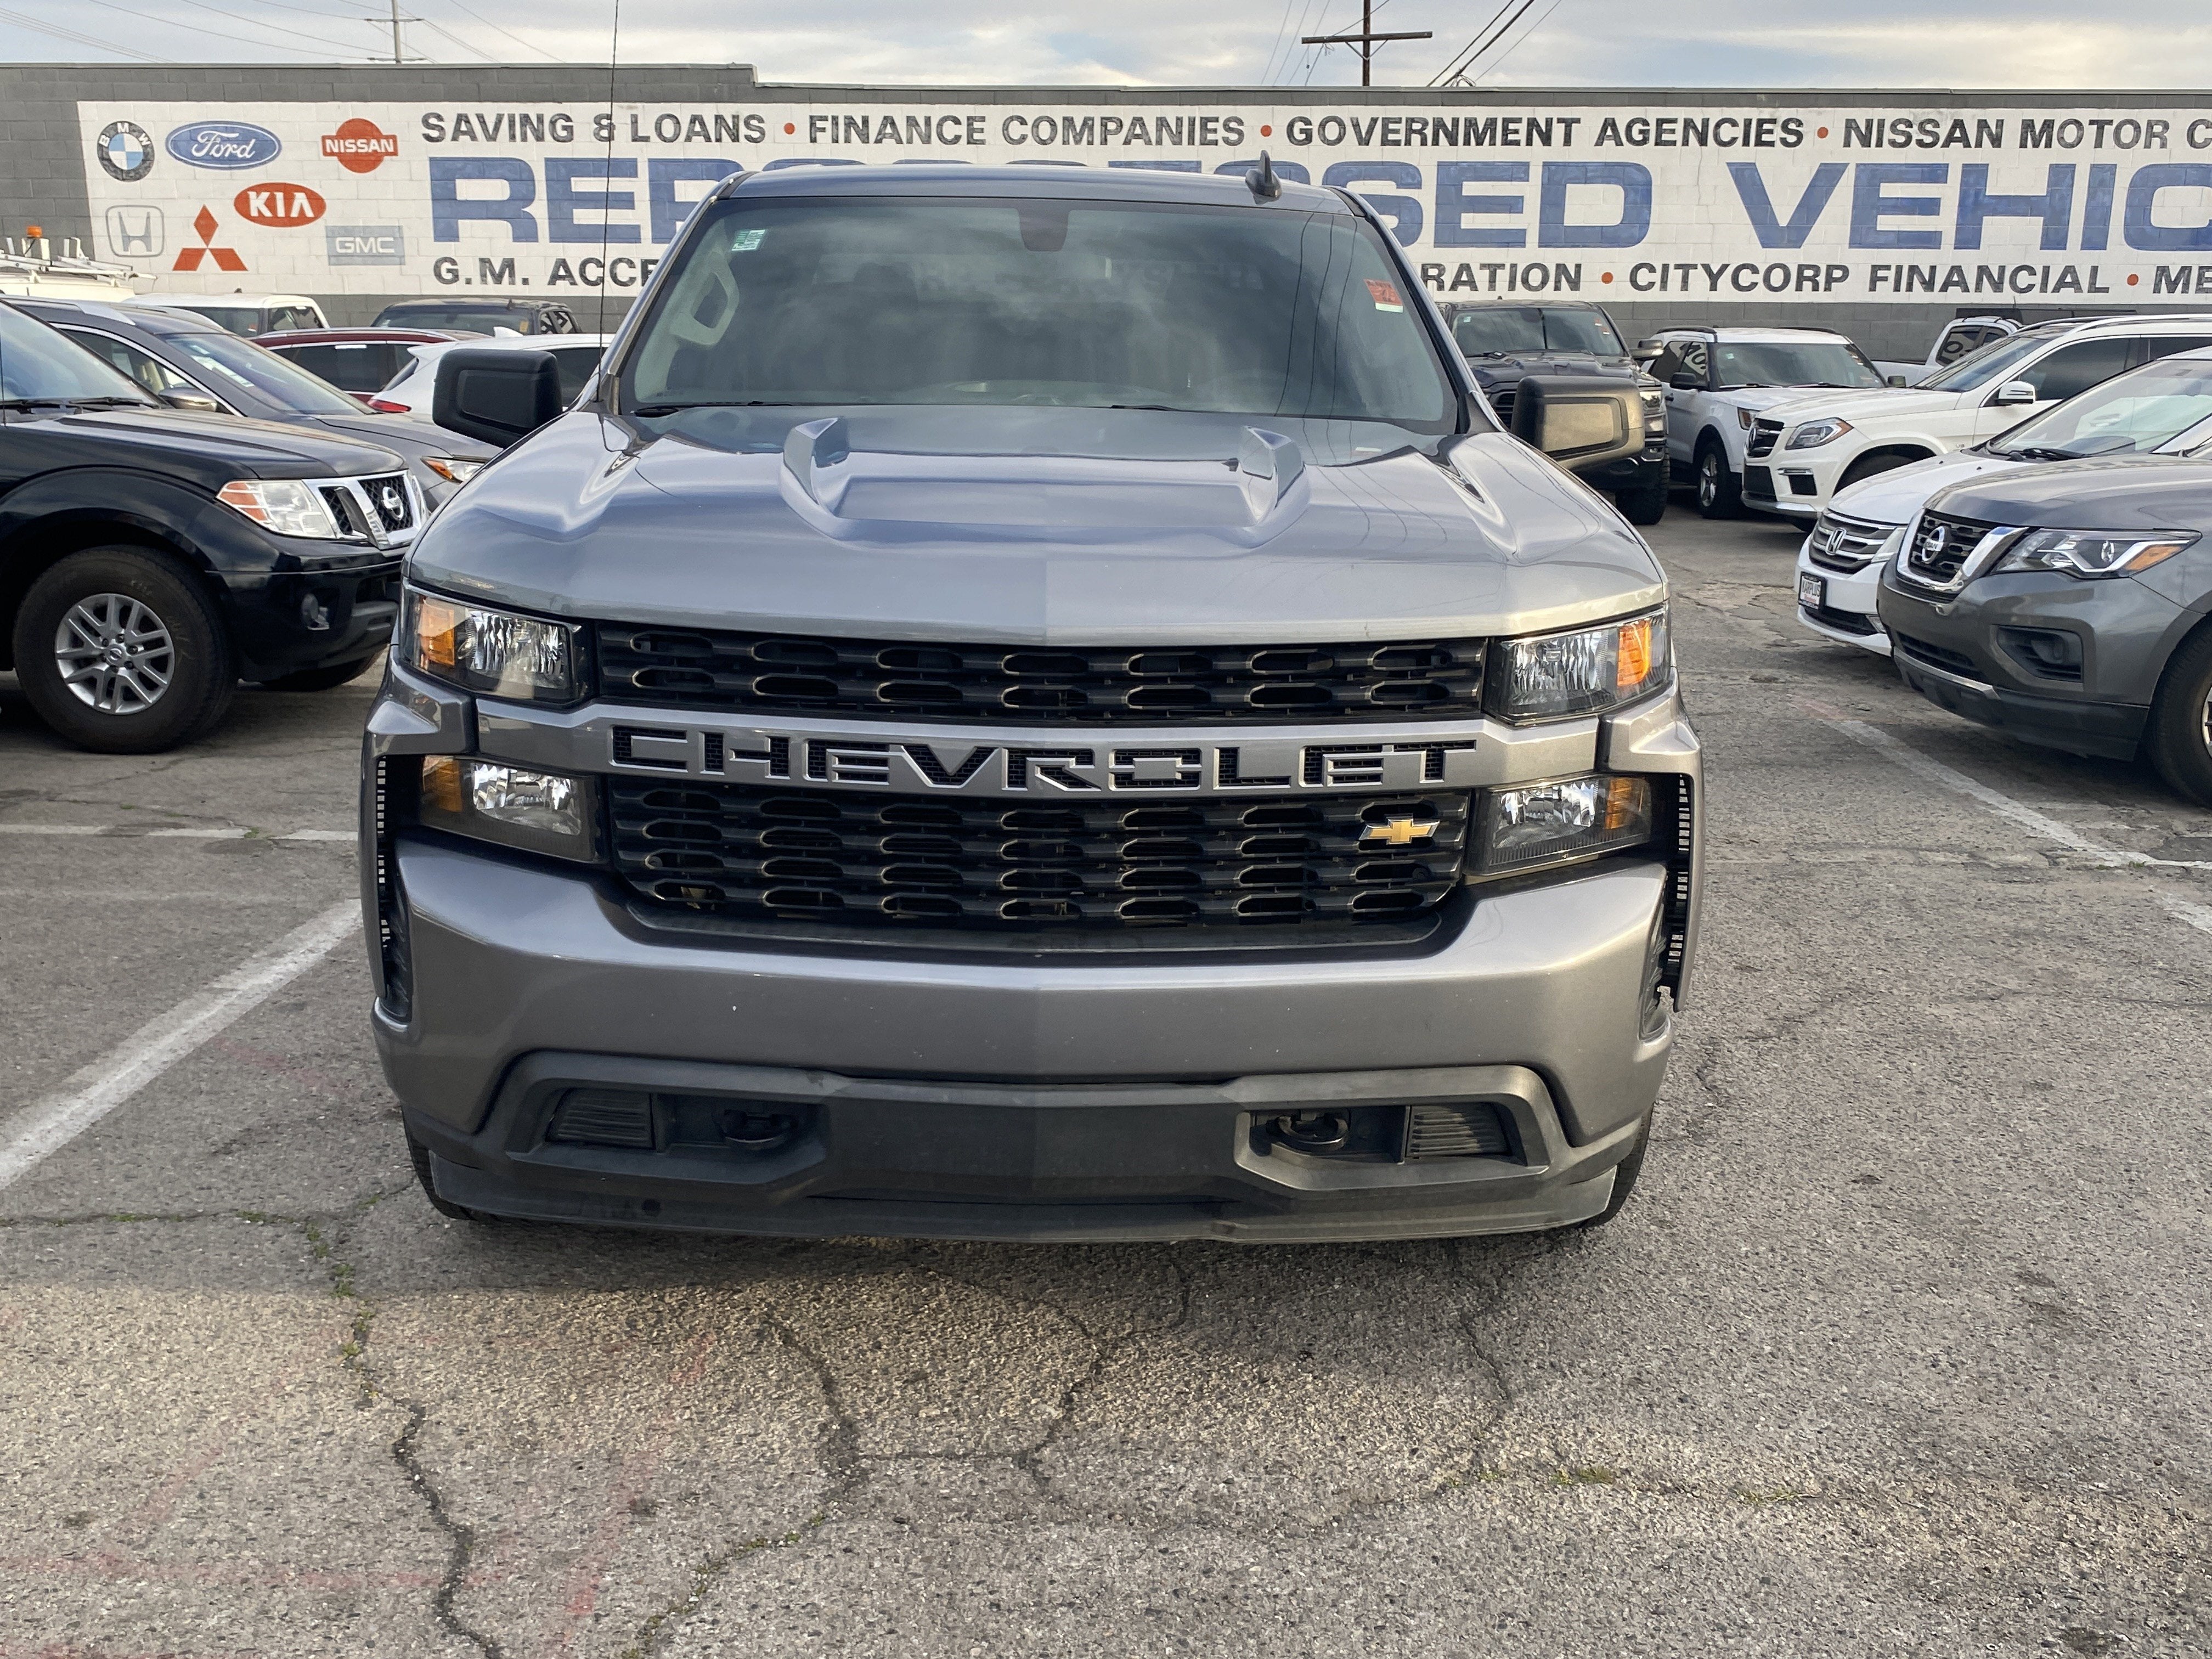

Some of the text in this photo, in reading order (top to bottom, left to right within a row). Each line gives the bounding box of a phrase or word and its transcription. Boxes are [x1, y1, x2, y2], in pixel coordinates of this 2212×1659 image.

[99, 122, 151, 147] BMW
[421, 112, 766, 143] SAVING & LOANS
[809, 115, 1245, 146] FINANCE COMPANIES
[1286, 116, 1804, 148] GOVERNMENT AGENCIES
[1843, 117, 2005, 149] NISSAN
[2018, 117, 2170, 149] MOTOR
[191, 130, 256, 159] Ford
[325, 139, 394, 153] NISSAN
[247, 191, 315, 218] KIA
[335, 237, 395, 253] GMC
[433, 257, 530, 285] G.M.
[1629, 262, 2110, 294] CITYCORP FINANCIAL
[612, 724, 1477, 792] CHEVROLET
